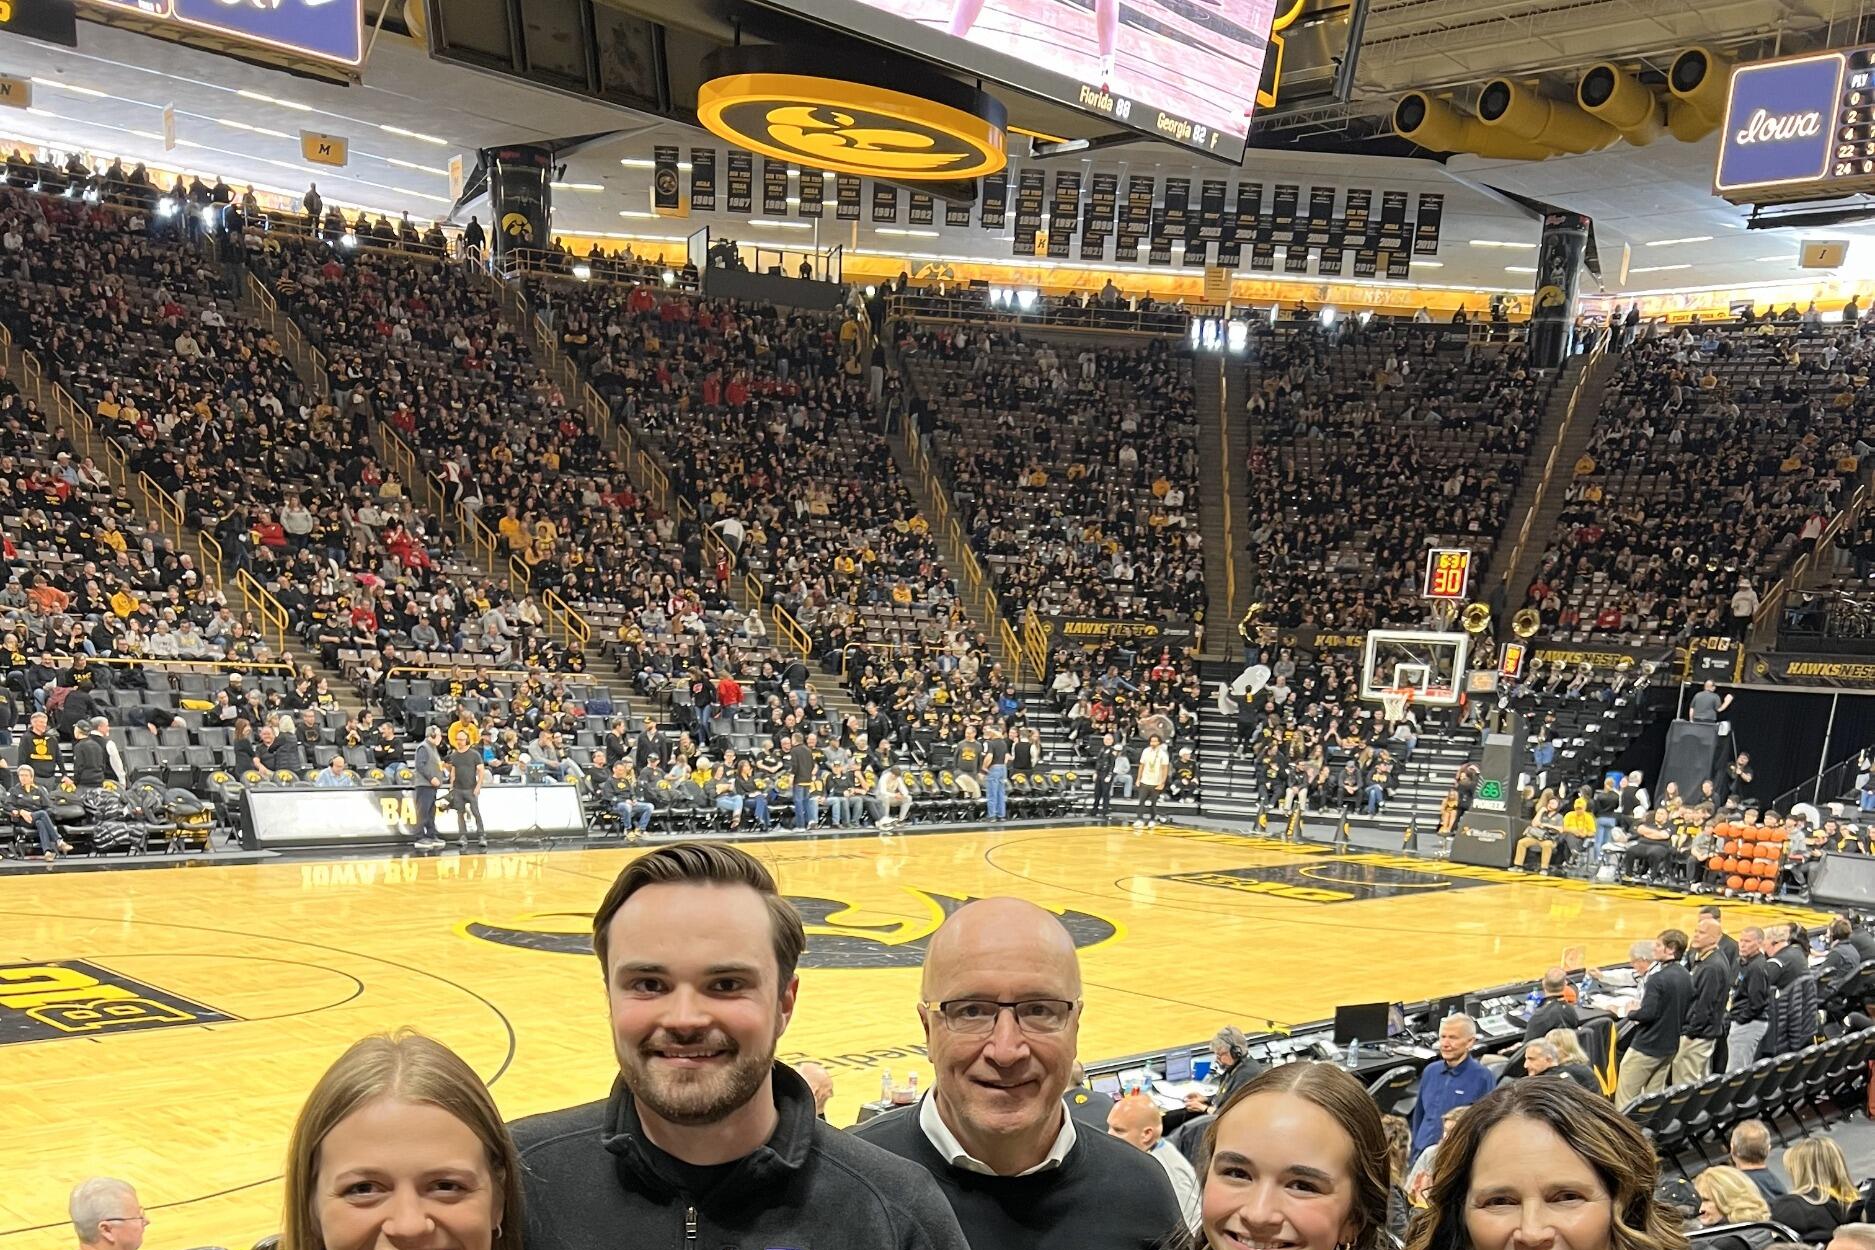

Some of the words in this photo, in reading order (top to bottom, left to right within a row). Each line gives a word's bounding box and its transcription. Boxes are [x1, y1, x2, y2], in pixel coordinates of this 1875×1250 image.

[1851, 74, 1868, 88] PLY
[1851, 92, 1860, 105] 0
[1080, 85, 1114, 112] Florida
[1157, 112, 1192, 139] Georgia
[1847, 110, 1857, 123] 2
[1736, 108, 1820, 144] Iowa
[1844, 128, 1854, 140] 4
[318, 143, 331, 155] M
[1838, 145, 1855, 158] 22
[1835, 163, 1851, 176] 24
[1055, 218, 1077, 228] 1997
[1037, 238, 1046, 249] K
[1434, 569, 1461, 593] 30
[1786, 662, 1875, 679] HAWKSNES
